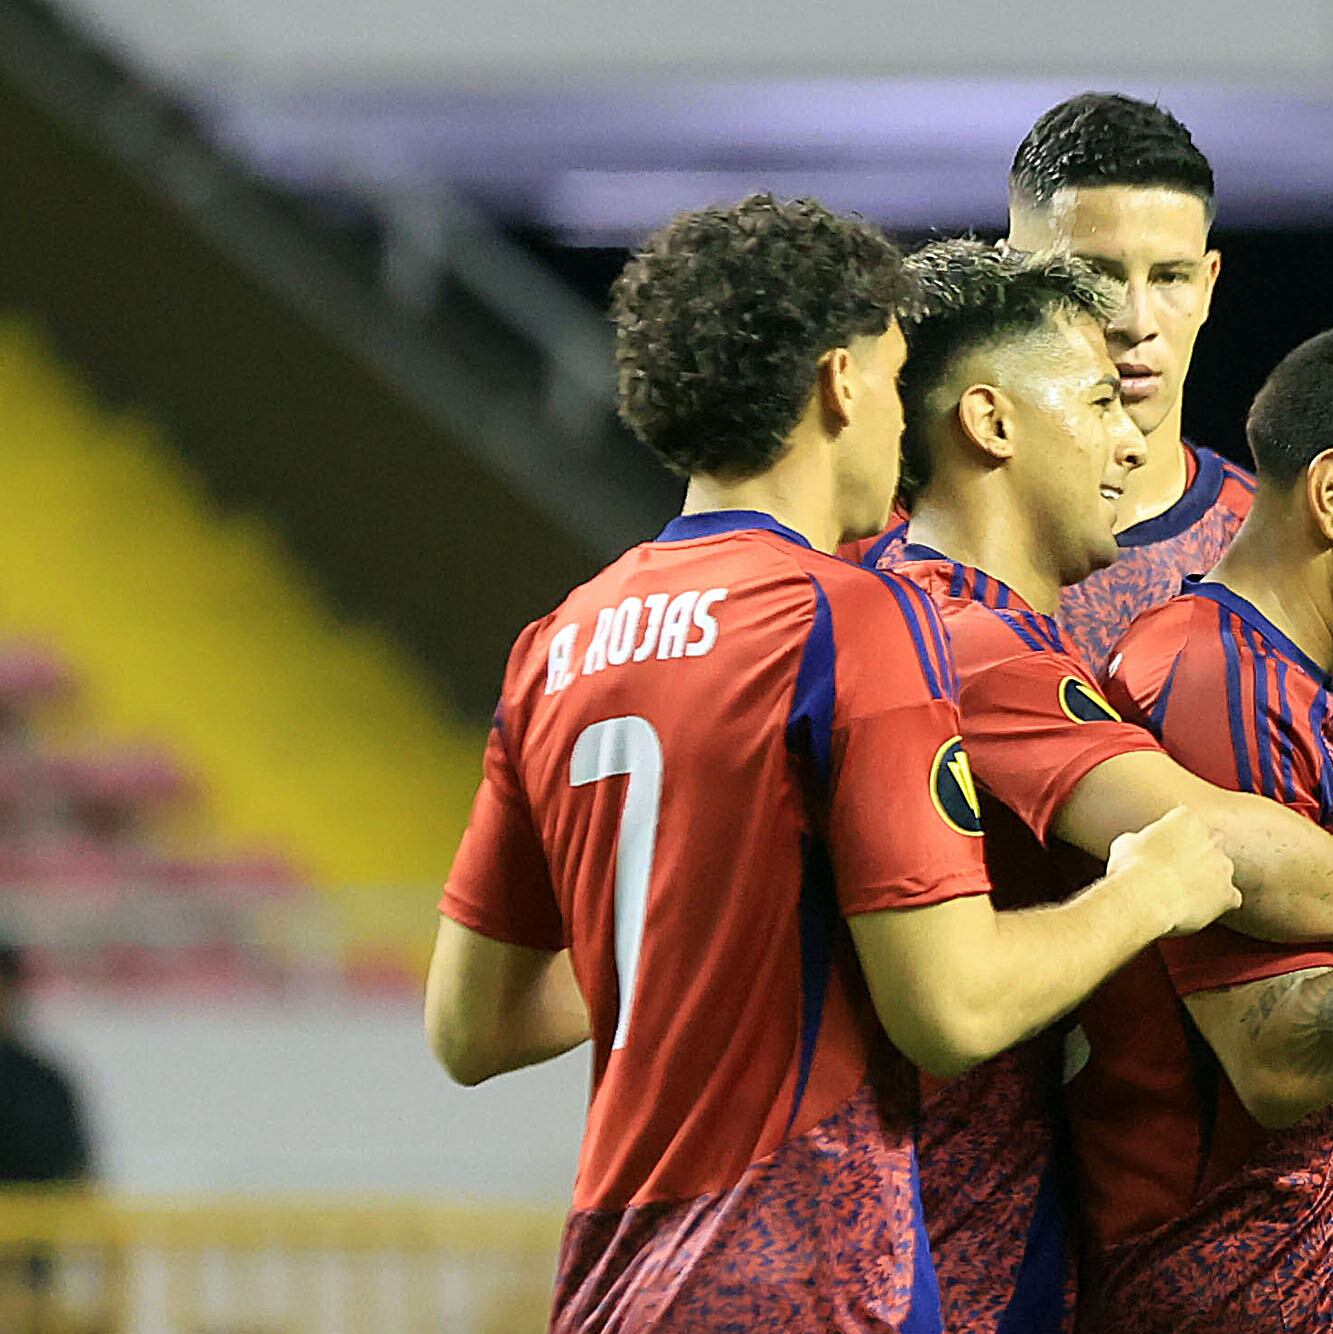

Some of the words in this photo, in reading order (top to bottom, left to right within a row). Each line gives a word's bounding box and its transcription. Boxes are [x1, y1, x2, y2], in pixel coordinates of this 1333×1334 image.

[544, 622, 580, 695] A.
[581, 588, 730, 676] ROJAS
[569, 715, 664, 1051] 7
